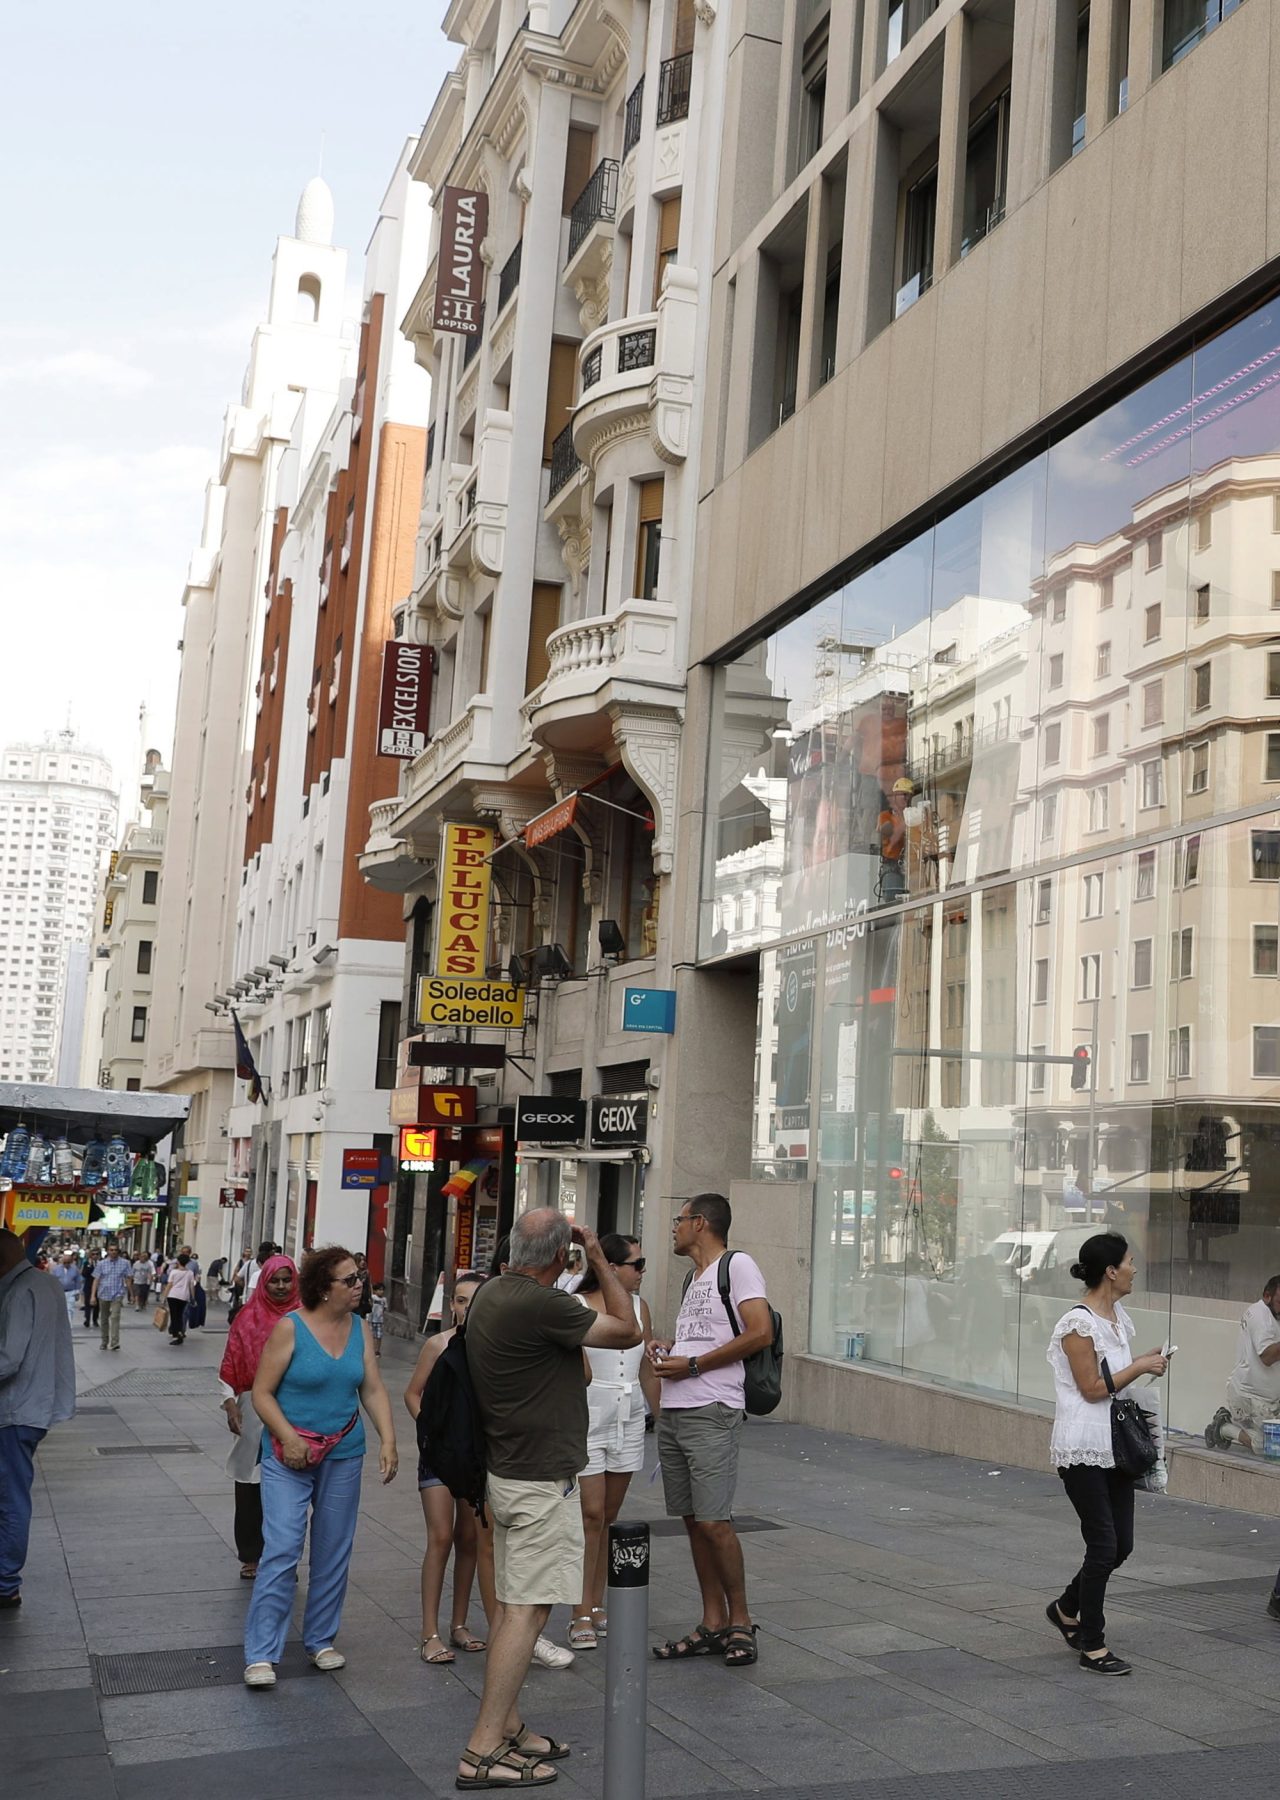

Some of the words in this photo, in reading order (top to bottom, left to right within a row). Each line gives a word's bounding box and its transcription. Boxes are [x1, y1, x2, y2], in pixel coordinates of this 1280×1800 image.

[450, 195, 477, 298] LAURIA
[392, 646, 422, 731] EXCELSIOR
[444, 827, 487, 975] PELUCAS
[428, 980, 518, 1003] Soledad
[430, 1004, 514, 1025] Cabello
[521, 1113, 575, 1124] GEOX
[599, 1105, 638, 1133] GEOX
[18, 1192, 88, 1205] TABACO
[17, 1209, 49, 1220] AGUA
